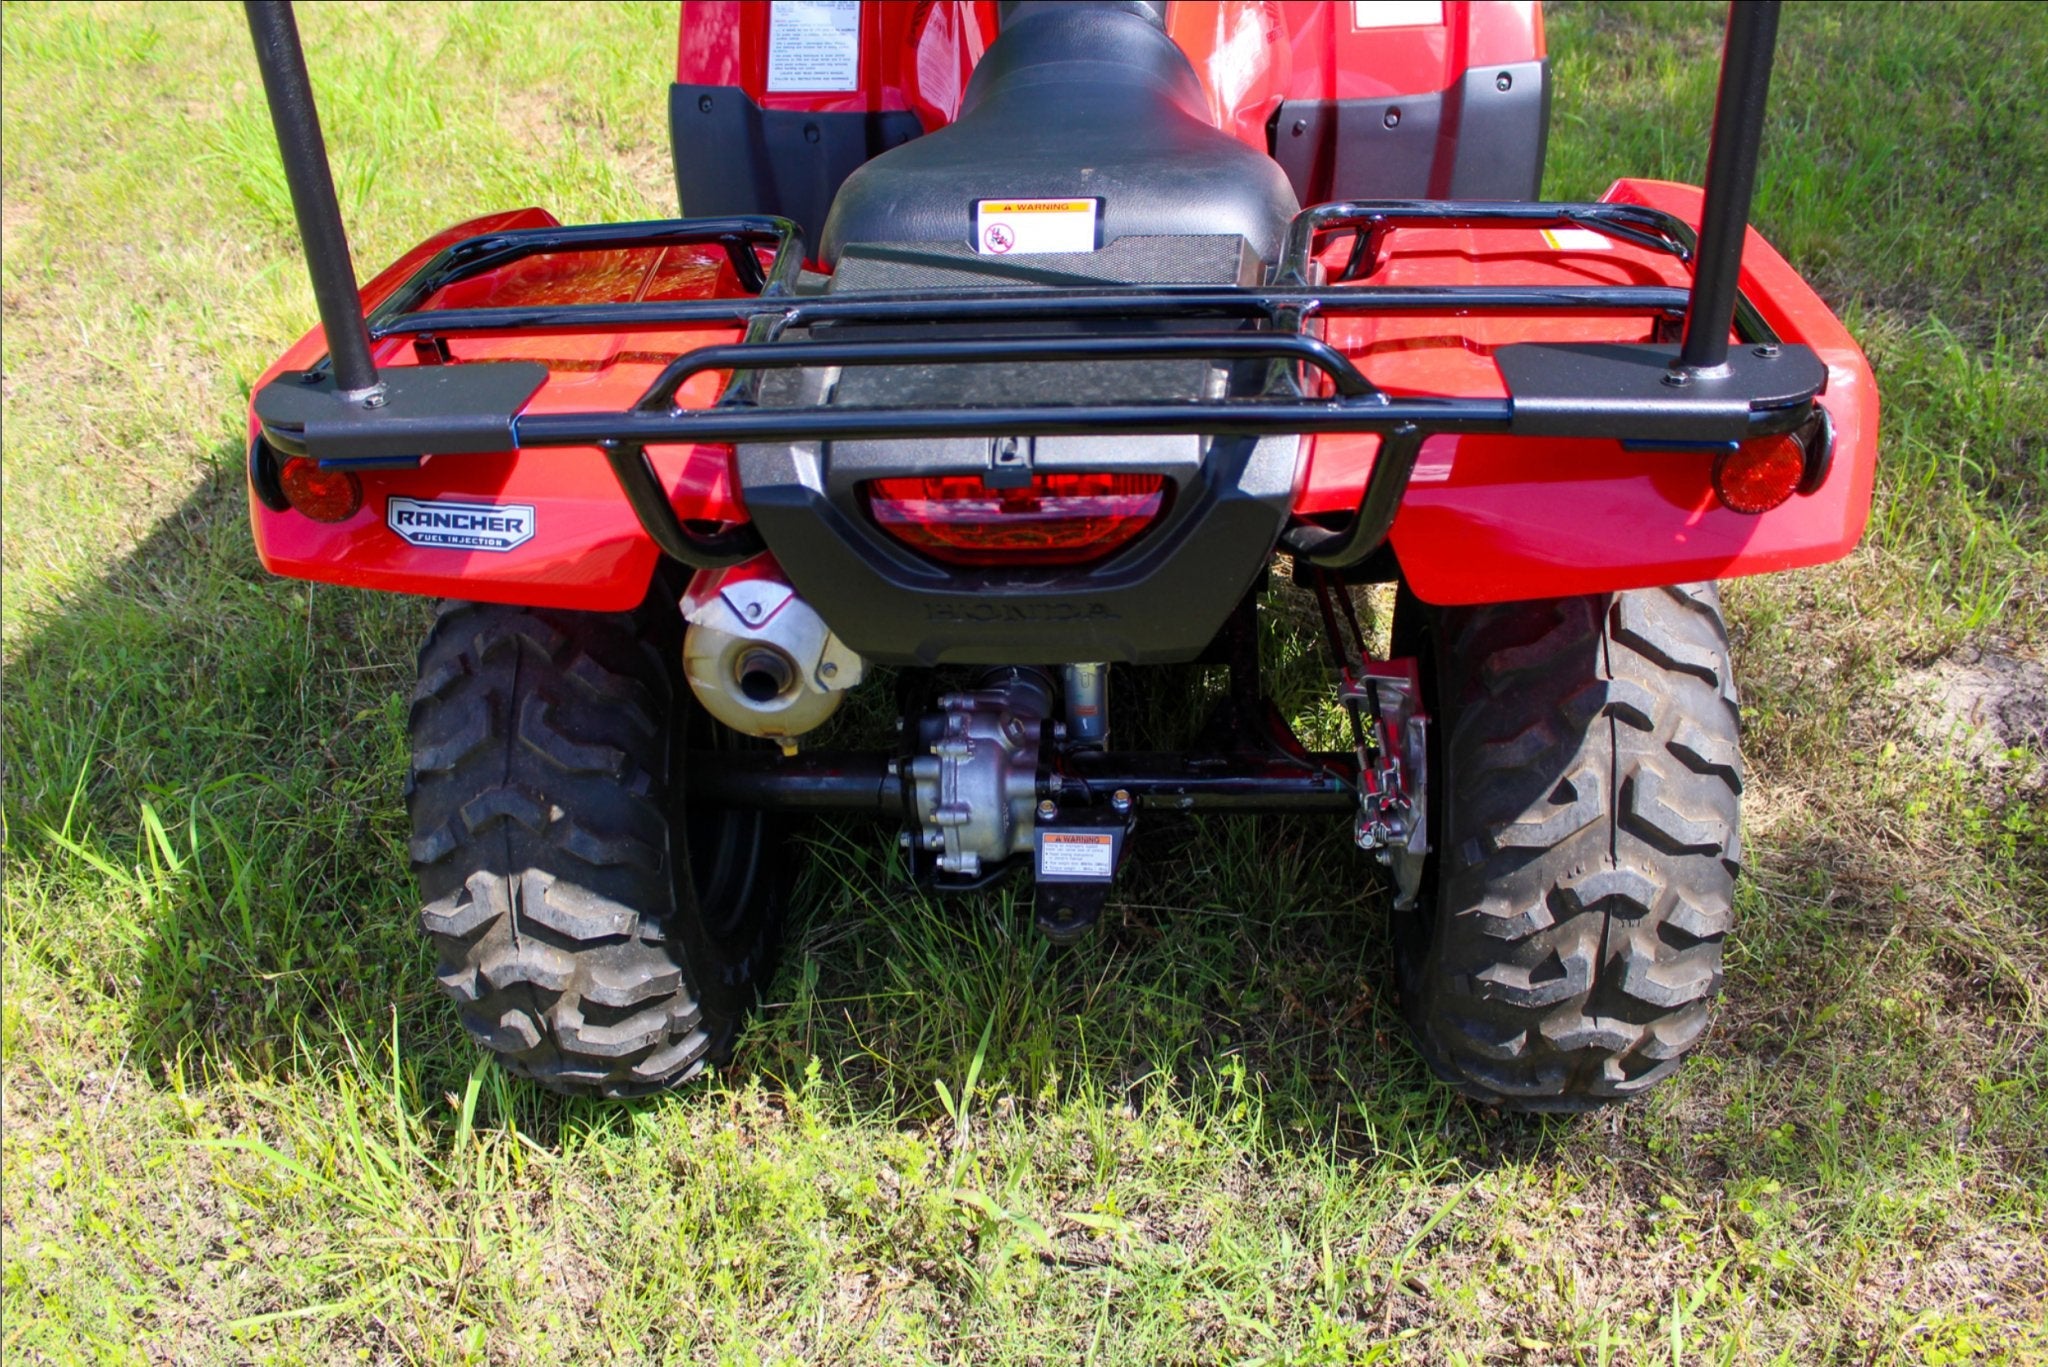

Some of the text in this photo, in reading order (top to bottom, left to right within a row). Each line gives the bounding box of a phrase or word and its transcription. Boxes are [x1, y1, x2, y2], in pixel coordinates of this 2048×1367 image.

[397, 510, 524, 533] RANCHER
[417, 534, 503, 546] FUEL INJECTION
[922, 602, 1121, 624] HONDA
[1063, 835, 1100, 844] WARNING
